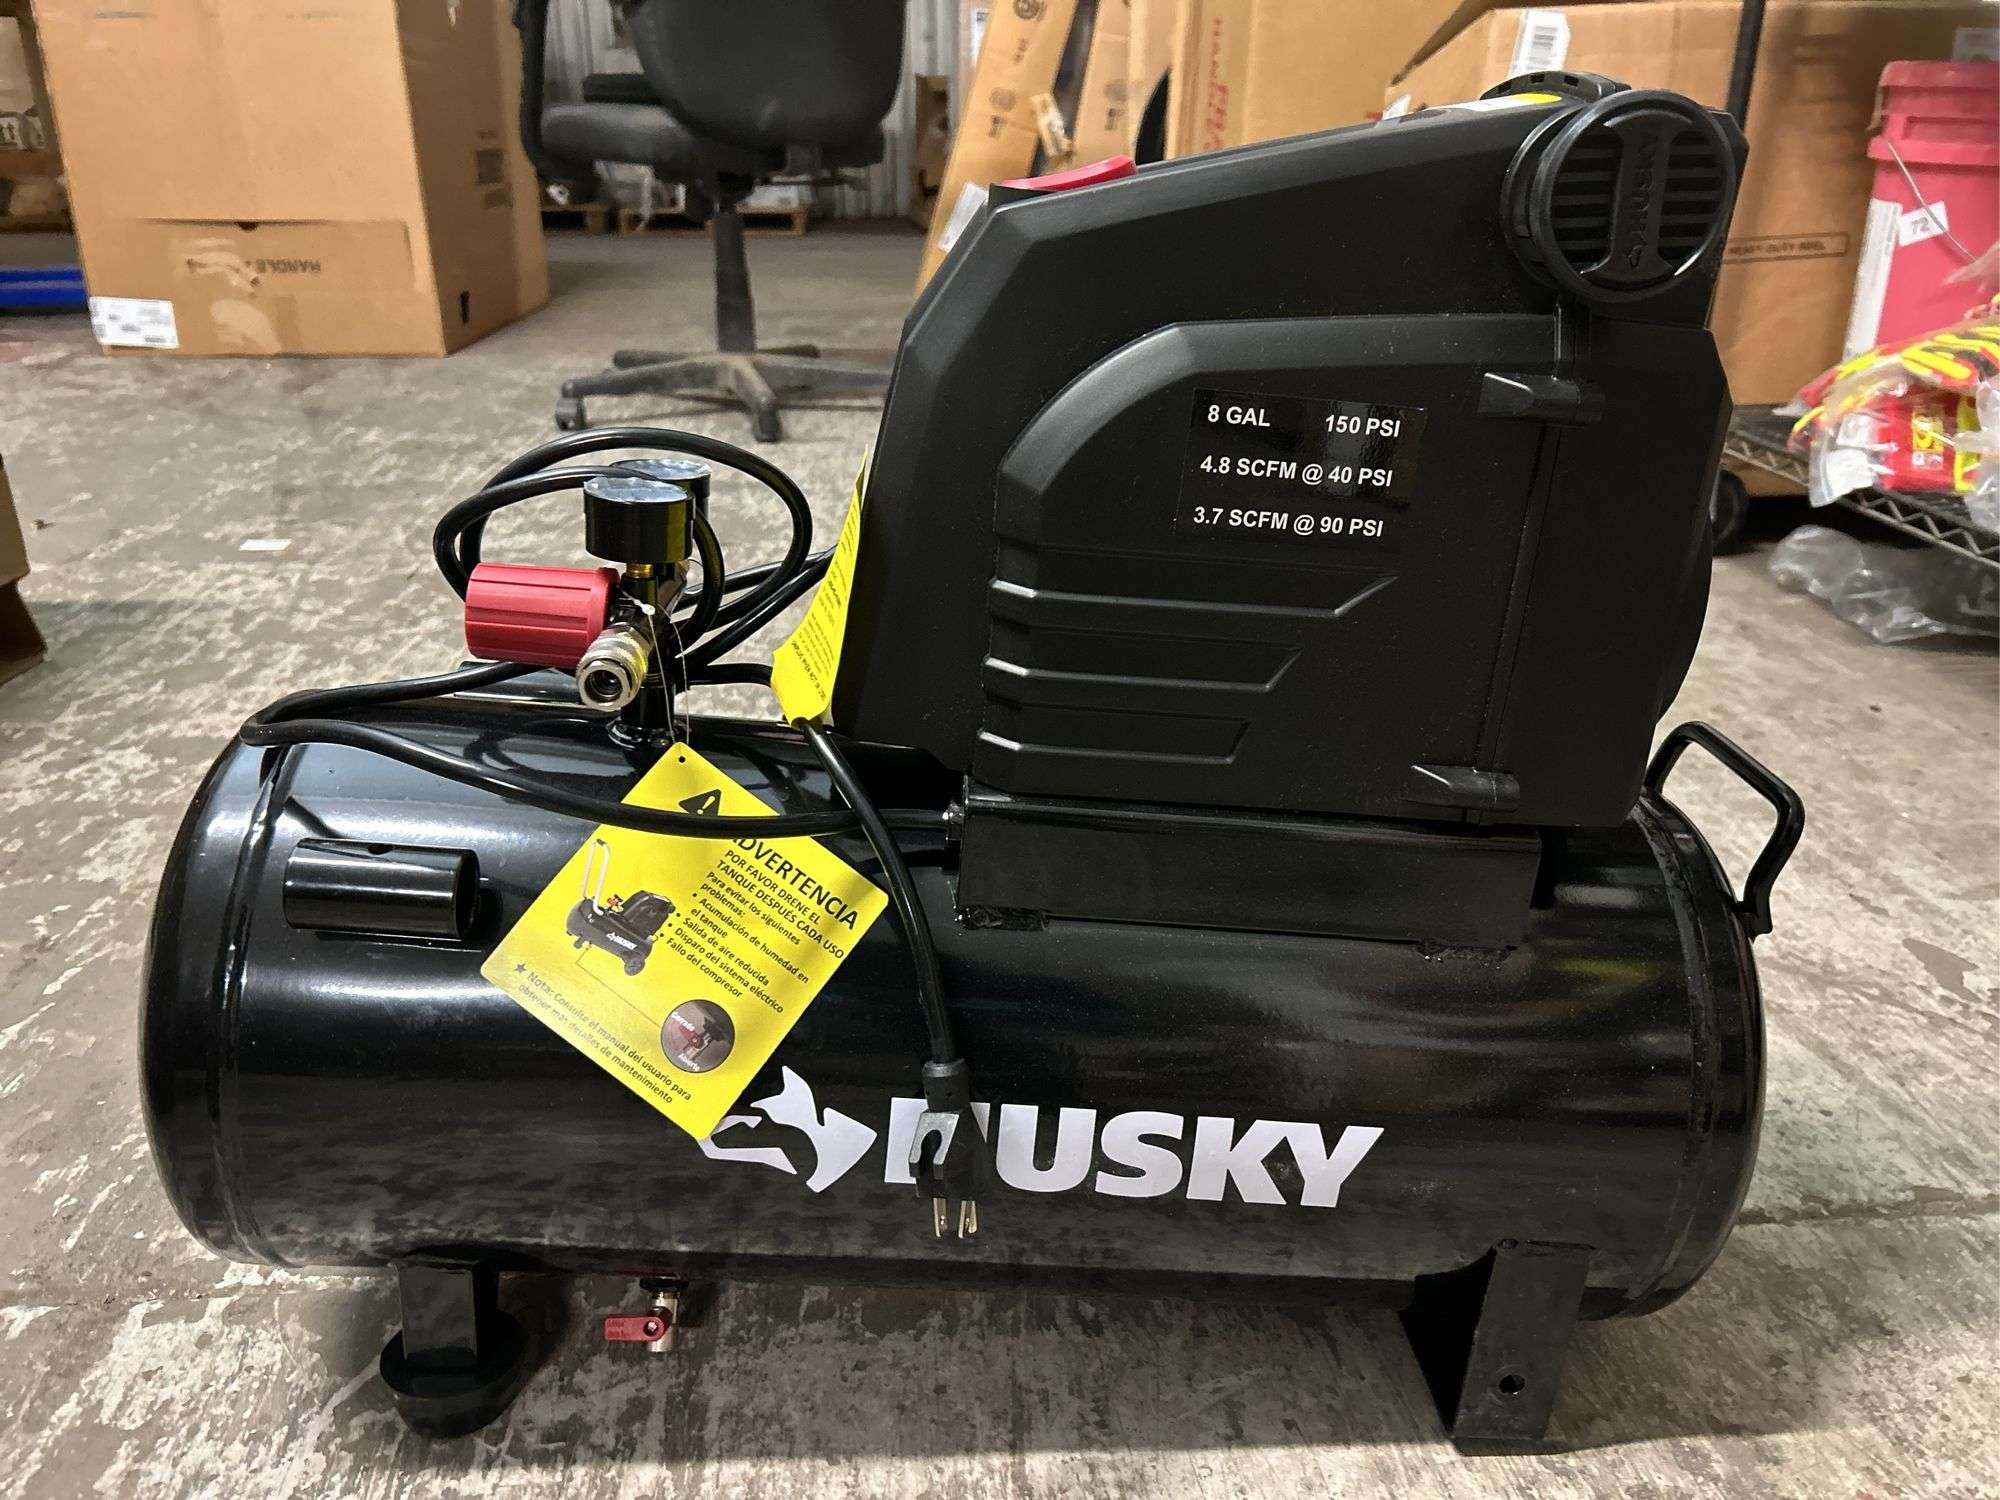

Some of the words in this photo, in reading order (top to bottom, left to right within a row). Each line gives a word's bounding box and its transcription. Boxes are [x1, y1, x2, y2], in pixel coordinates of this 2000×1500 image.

[1207, 404, 1221, 423] 8
[1225, 405, 1271, 427] GAL
[1324, 414, 1362, 435] 150
[1365, 416, 1401, 438] PSI
[1199, 454, 1231, 475] 4.8
[1236, 457, 1298, 480] SCFM
[1301, 463, 1324, 485] @
[1328, 465, 1353, 485] 40
[1358, 468, 1393, 488] PSI
[1192, 506, 1224, 526] 3.7
[1228, 508, 1289, 530] SCFM
[1293, 513, 1316, 536] @
[1319, 516, 1344, 535] 90
[1349, 518, 1384, 538] PSI
[701, 882, 746, 917] problemas:
[707, 872, 726, 888] Para
[726, 886, 749, 905] evitar
[749, 903, 762, 914] los
[761, 912, 801, 945] siguientes
[716, 860, 756, 892] TANQUE
[755, 888, 798, 922] DESPUÉS
[796, 920, 824, 943] CADA
[823, 940, 844, 958] USO
[725, 850, 747, 868] POR
[746, 865, 778, 891] FAVOR
[778, 889, 809, 914] DRENE
[809, 912, 821, 924] EL
[732, 839, 859, 929] DVERTENCIA
[683, 917, 708, 938] Salida
[707, 936, 719, 946] de
[719, 945, 735, 959] aire
[735, 957, 770, 985] reducida
[690, 907, 701, 916] el
[699, 915, 728, 938] tanque
[699, 897, 750, 937] Acumulación
[749, 935, 761, 946] de
[760, 944, 799, 974] humedad
[797, 972, 809, 982] en
[667, 938, 687, 955] Fallo
[686, 953, 701, 965] del
[699, 964, 742, 997] compresor
[674, 928, 706, 954] Disparo
[705, 951, 720, 963] del
[718, 961, 750, 986] sistema
[749, 984, 785, 1012] eléctrico
[588, 1019, 599, 1029] el
[597, 1026, 629, 1052] manual
[628, 1049, 643, 1062] del
[642, 1060, 673, 1085] usuario
[671, 1084, 692, 1100] para
[600, 1045, 613, 1056] de
[611, 1054, 674, 1103] mantenimiento
